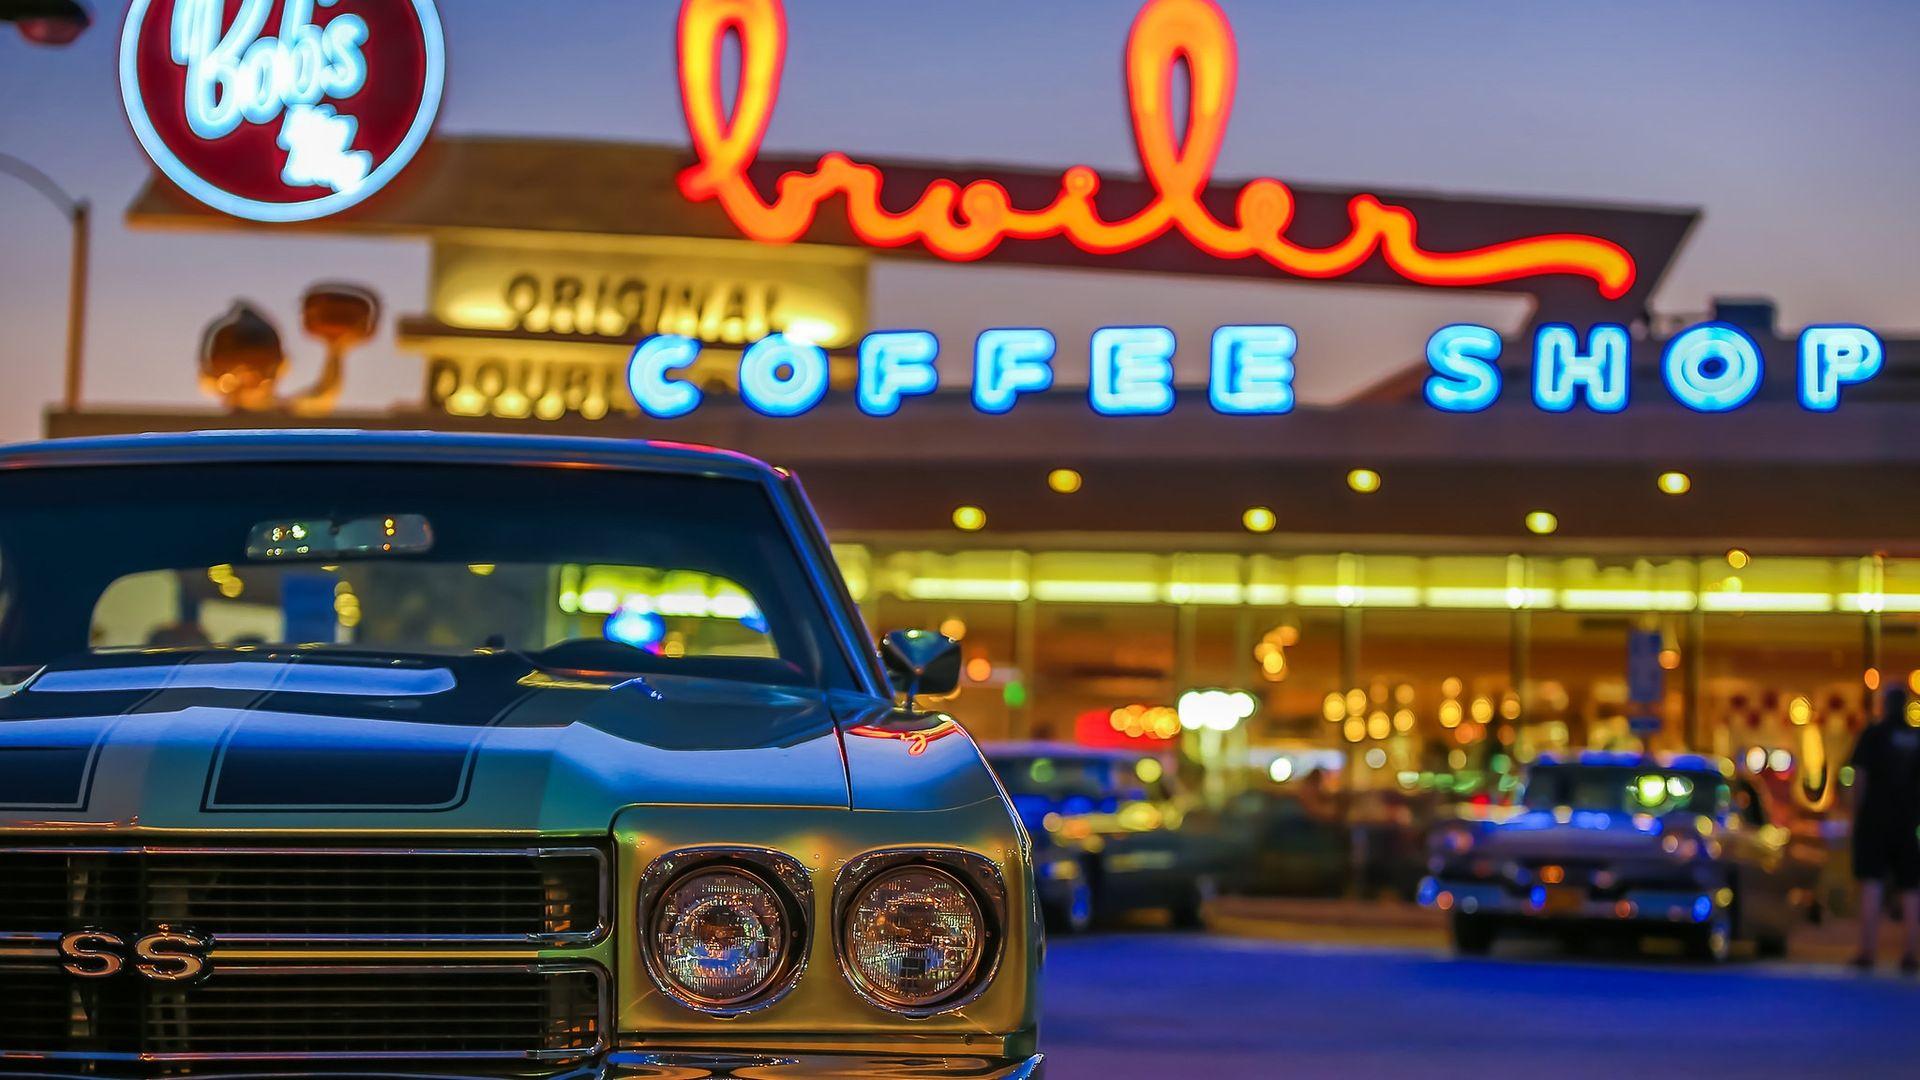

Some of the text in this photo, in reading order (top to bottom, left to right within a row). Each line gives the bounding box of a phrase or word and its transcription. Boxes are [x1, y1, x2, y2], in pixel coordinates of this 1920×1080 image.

[677, 0, 1637, 300] broiler
[507, 272, 781, 334] ORIGINAL
[430, 356, 640, 413] DOUBL
[628, 322, 1884, 418] COFFEE SHOP
